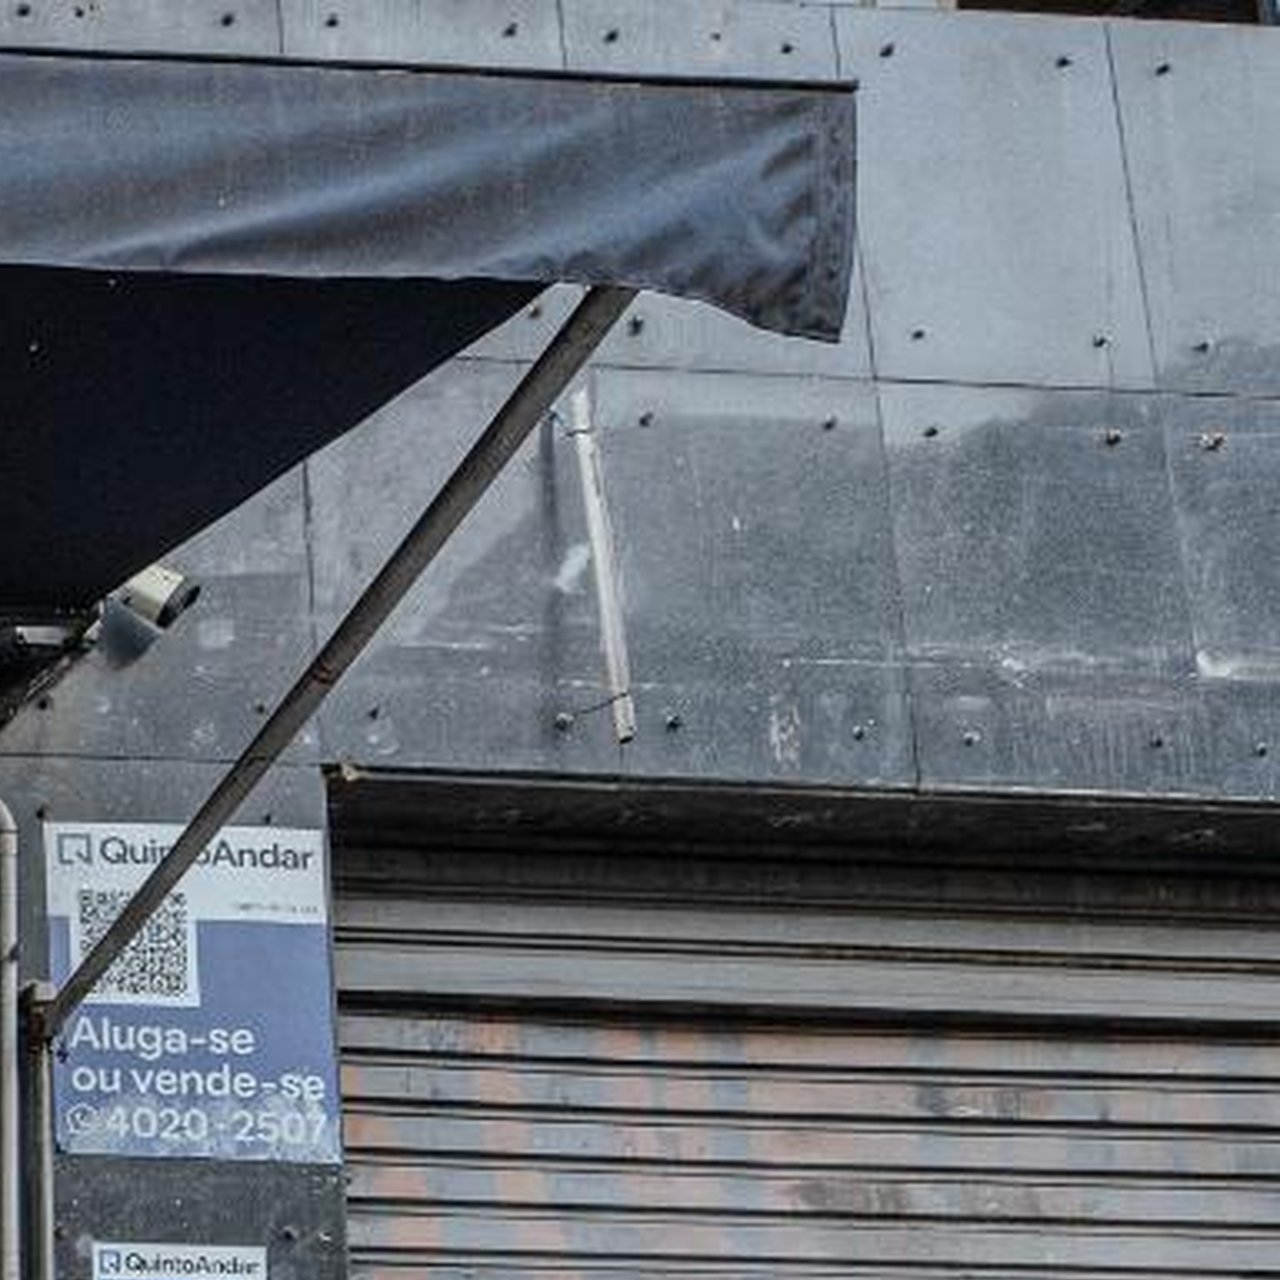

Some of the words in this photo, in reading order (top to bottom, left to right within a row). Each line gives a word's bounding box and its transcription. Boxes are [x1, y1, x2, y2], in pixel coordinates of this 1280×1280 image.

[100, 836, 313, 871] QuioAndar
[71, 1016, 255, 1060] Aluga-se
[72, 1066, 121, 1092] ou
[132, 1063, 325, 1100] vende-se
[125, 1251, 261, 1276] QuintoAndar
